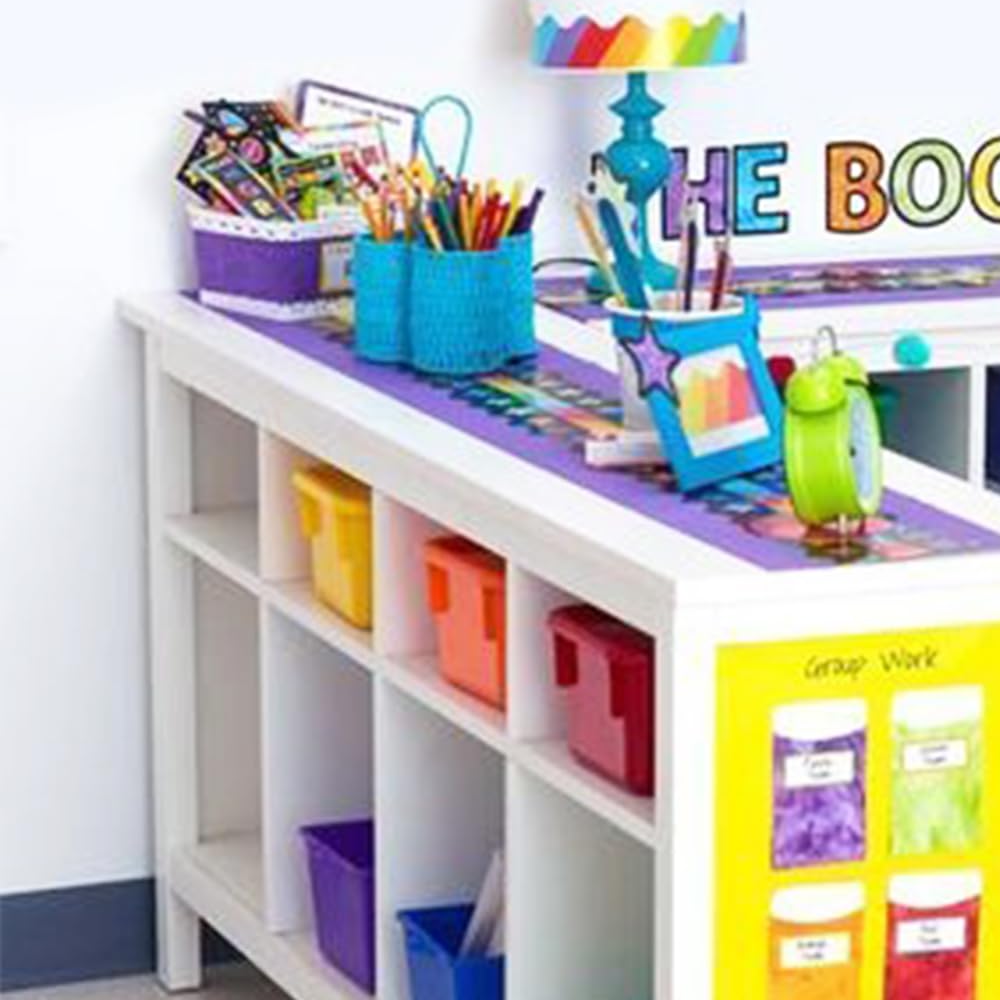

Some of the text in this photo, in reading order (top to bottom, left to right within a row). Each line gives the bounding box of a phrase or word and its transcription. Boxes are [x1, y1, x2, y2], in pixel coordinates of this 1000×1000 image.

[590, 142, 789, 241] HE
[804, 645, 938, 680] Group Work
